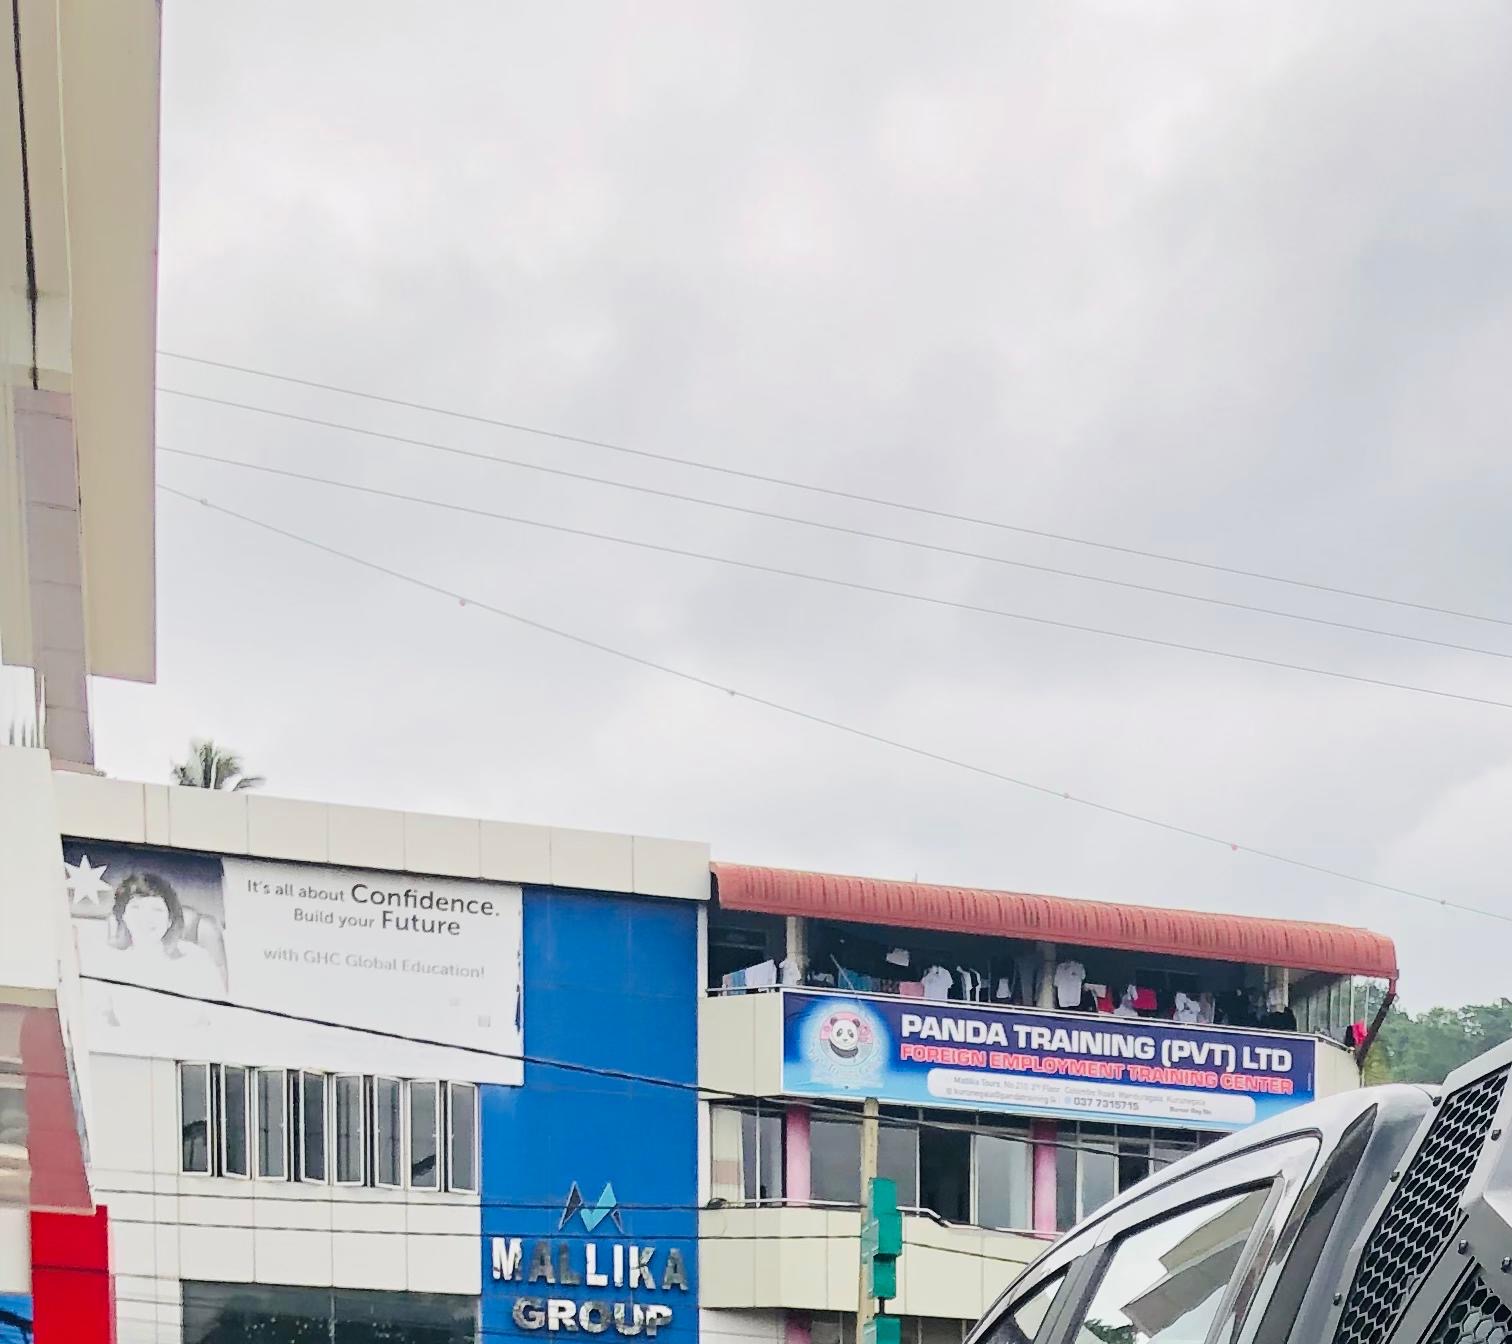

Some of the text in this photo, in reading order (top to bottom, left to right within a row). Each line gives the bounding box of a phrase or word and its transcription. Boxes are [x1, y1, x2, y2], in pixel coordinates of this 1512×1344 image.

[247, 880, 500, 916] It's all about Confidence.
[294, 908, 461, 936] Build your Future
[263, 947, 486, 978] with GHC Global Education!
[901, 1013, 1293, 1073] PANDA TRAINING (PVT) LTD
[901, 1043, 987, 1068] FOREIGN
[989, 1051, 1125, 1080] EMPLOYMENT
[1128, 1064, 1218, 1087] TRAINING
[1220, 1073, 1294, 1095] CENTER
[492, 1237, 688, 1291] MALLIKA
[512, 1297, 673, 1336] GROUP
